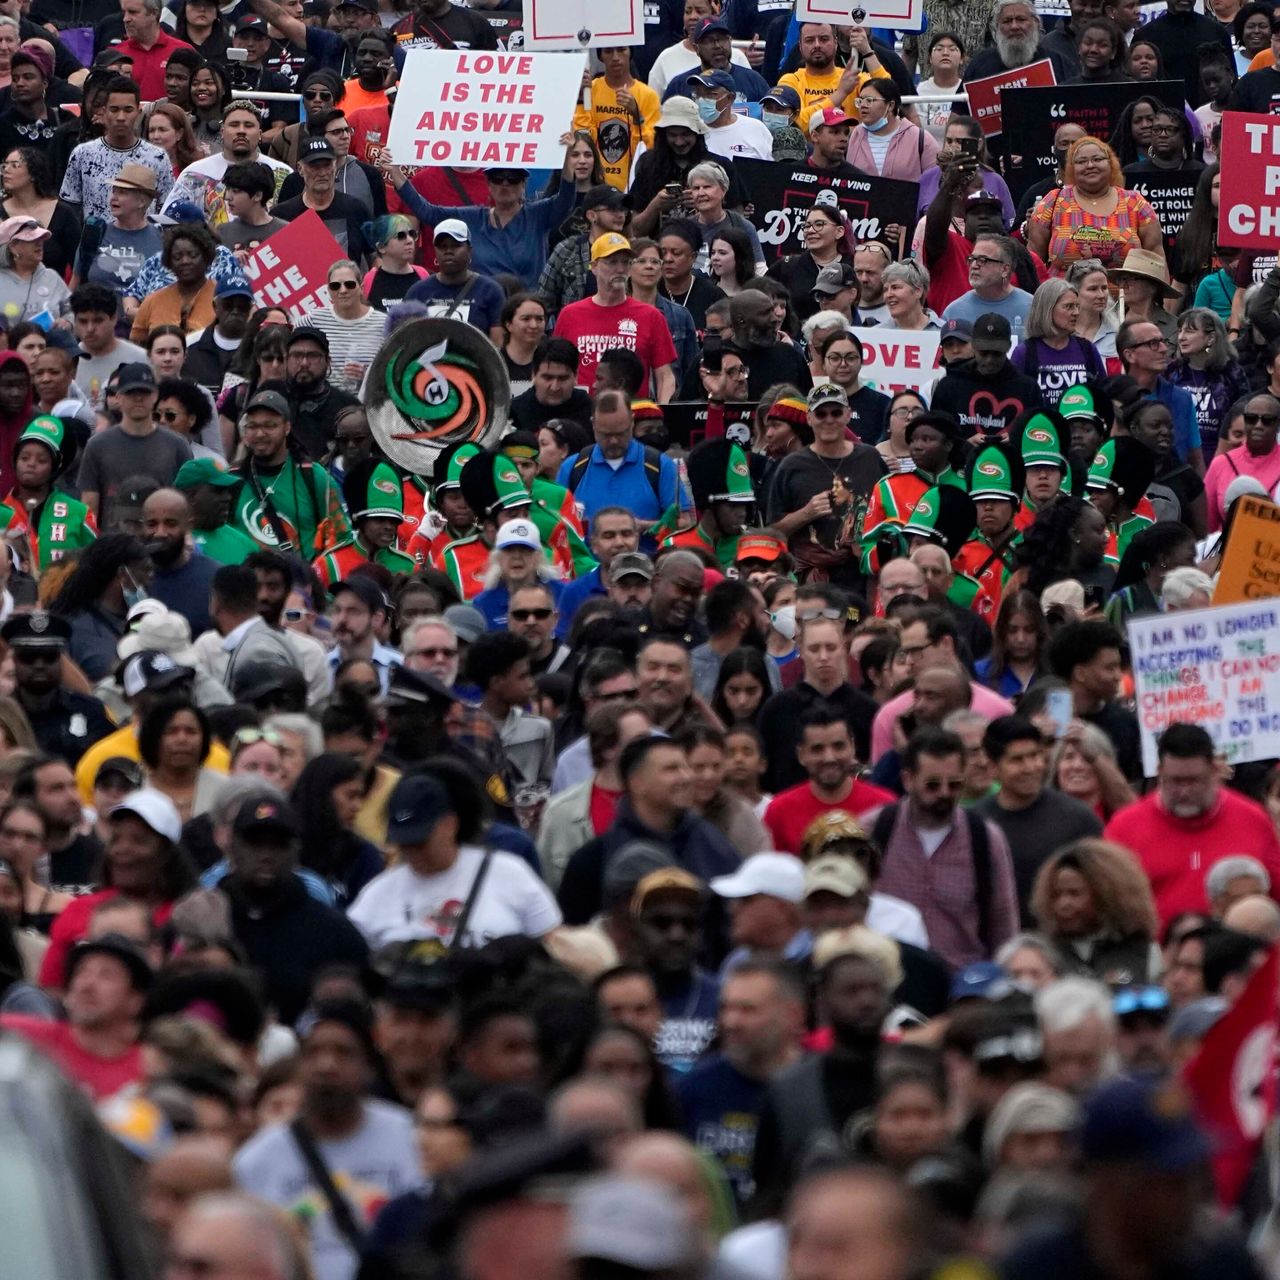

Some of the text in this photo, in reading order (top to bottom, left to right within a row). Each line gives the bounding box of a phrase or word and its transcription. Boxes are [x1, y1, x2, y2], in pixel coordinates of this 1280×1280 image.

[456, 54, 534, 76] LOVE
[440, 82, 535, 104] IS THE
[993, 77, 1028, 95] FIGHT
[416, 111, 545, 134] ANSWER
[414, 140, 537, 163] TO HATE
[791, 172, 871, 192] KEEP MOVING
[1167, 201, 1193, 210] ROLL
[100, 245, 137, 258] Y'all
[243, 241, 281, 280] VE
[252, 265, 309, 312] THE
[578, 336, 636, 346] SEPARATION OF
[860, 342, 921, 369] OVE
[1037, 370, 1087, 391] LOVE
[1136, 611, 1277, 649] I AM NO LONGER
[1139, 637, 1265, 673] ACCEPTING THE
[1141, 665, 1201, 689] THINGS
[1208, 663, 1215, 680] I
[1218, 659, 1252, 680] CAN
[1222, 677, 1263, 697] I AM
[1143, 697, 1267, 730] CHANGING THE
[1228, 719, 1251, 738] DO
